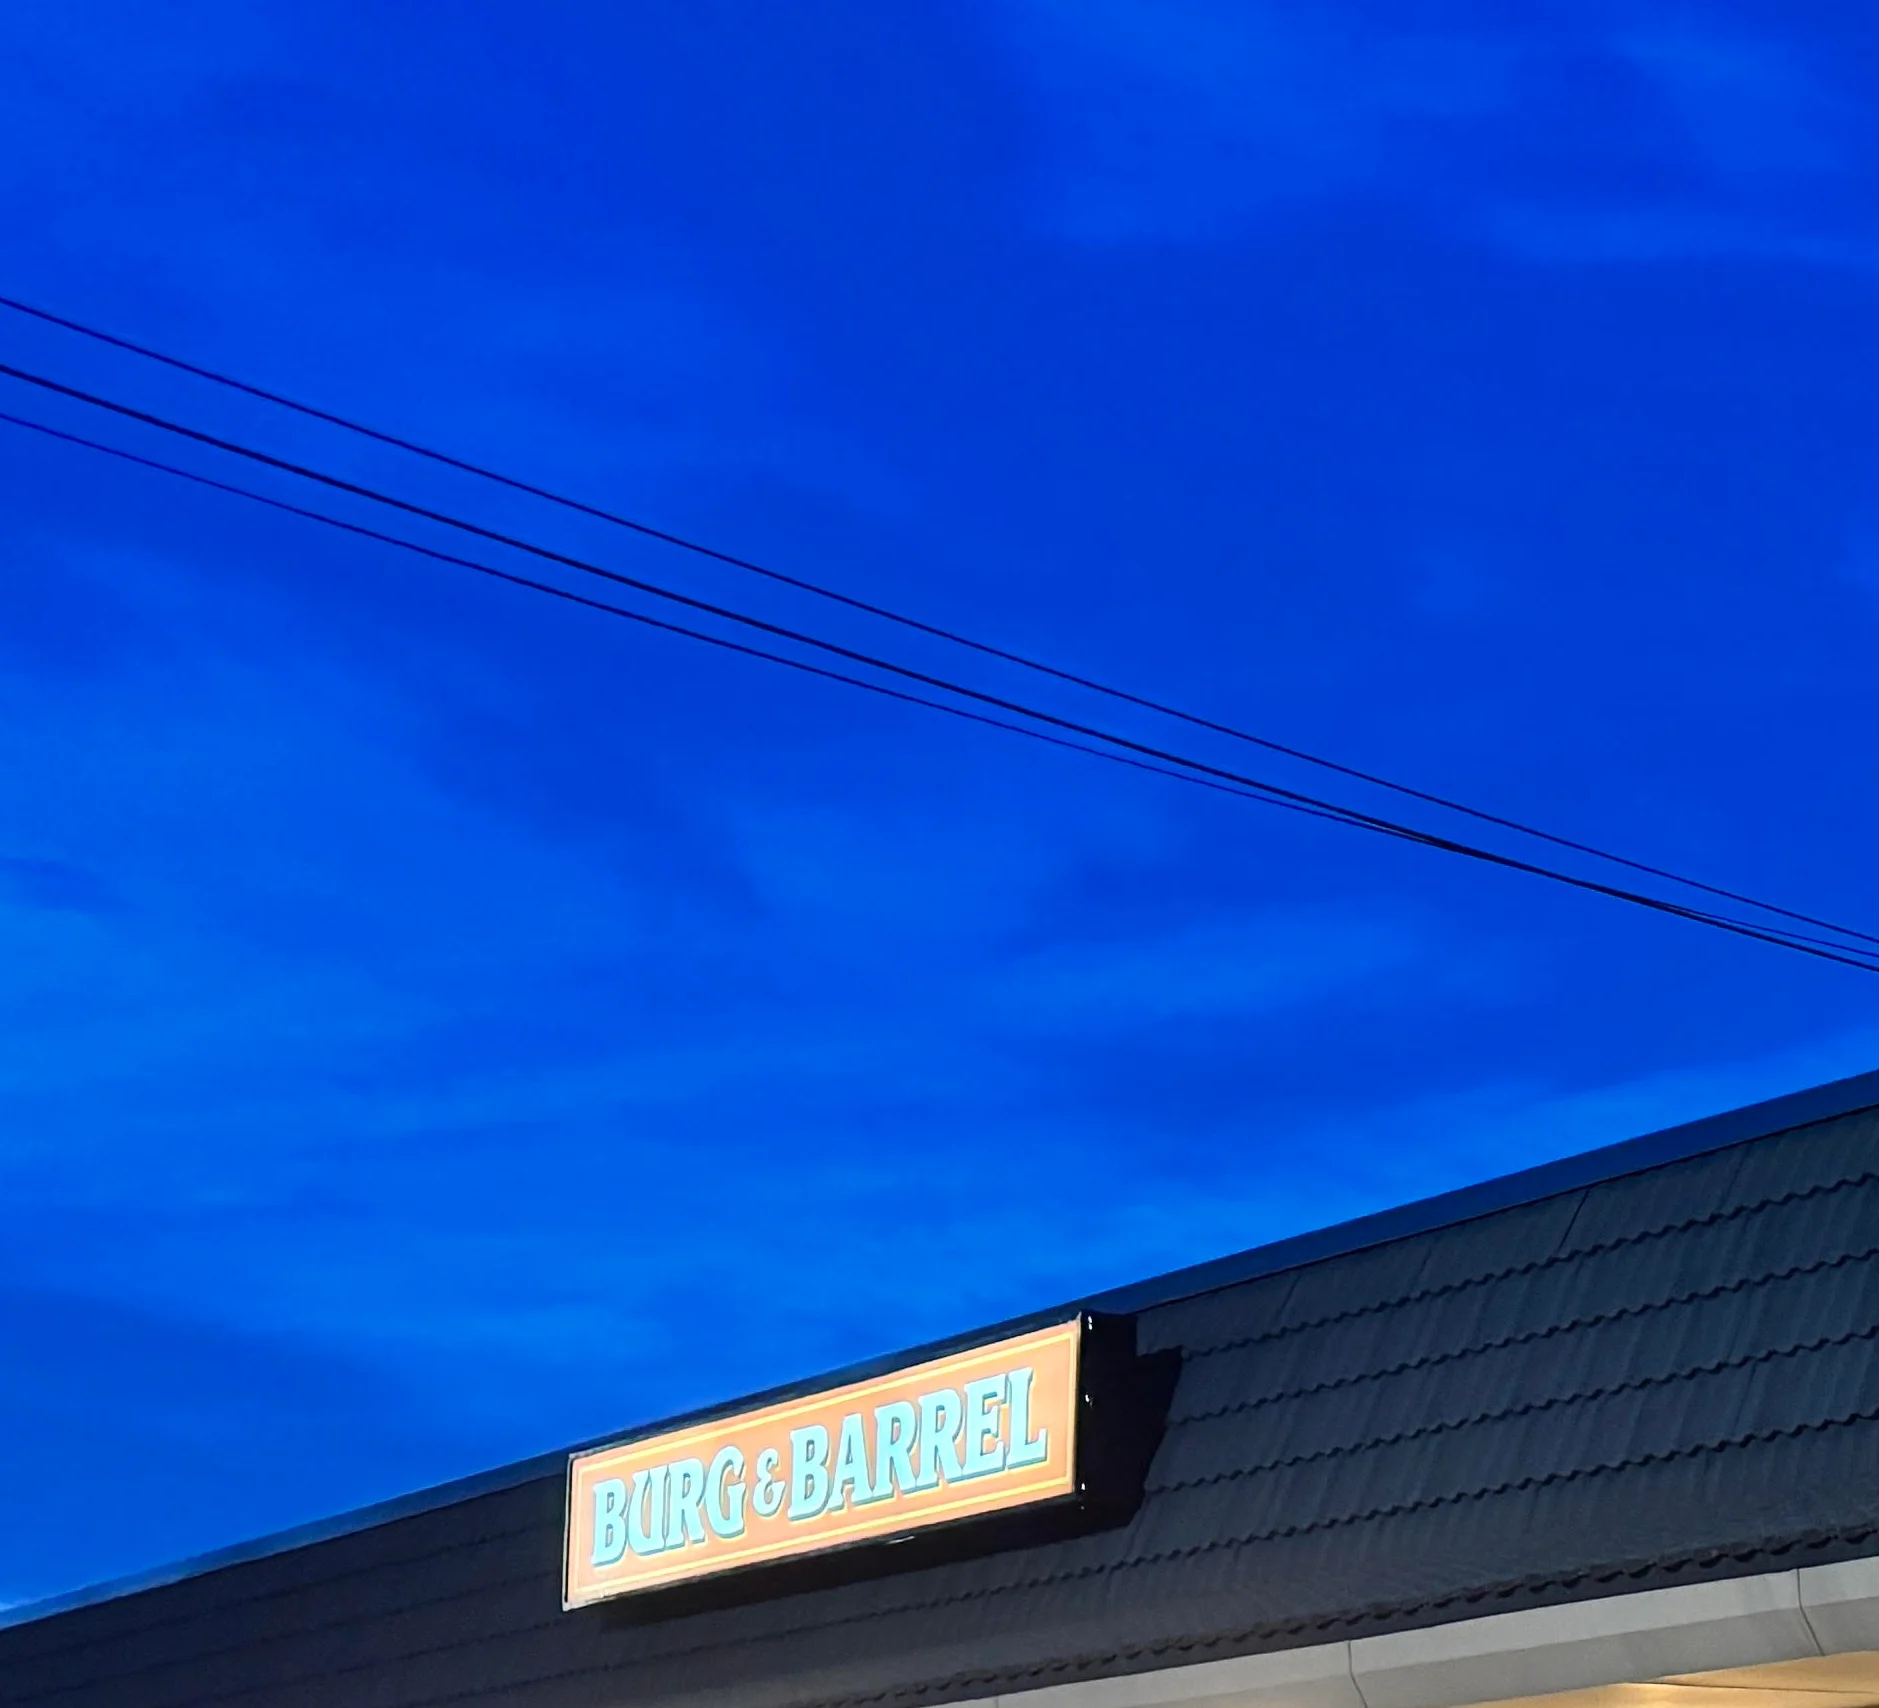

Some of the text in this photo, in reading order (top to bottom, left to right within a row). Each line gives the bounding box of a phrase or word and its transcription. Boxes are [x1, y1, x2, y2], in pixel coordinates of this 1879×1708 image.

[591, 1366, 1049, 1567] BURG & BARREL
